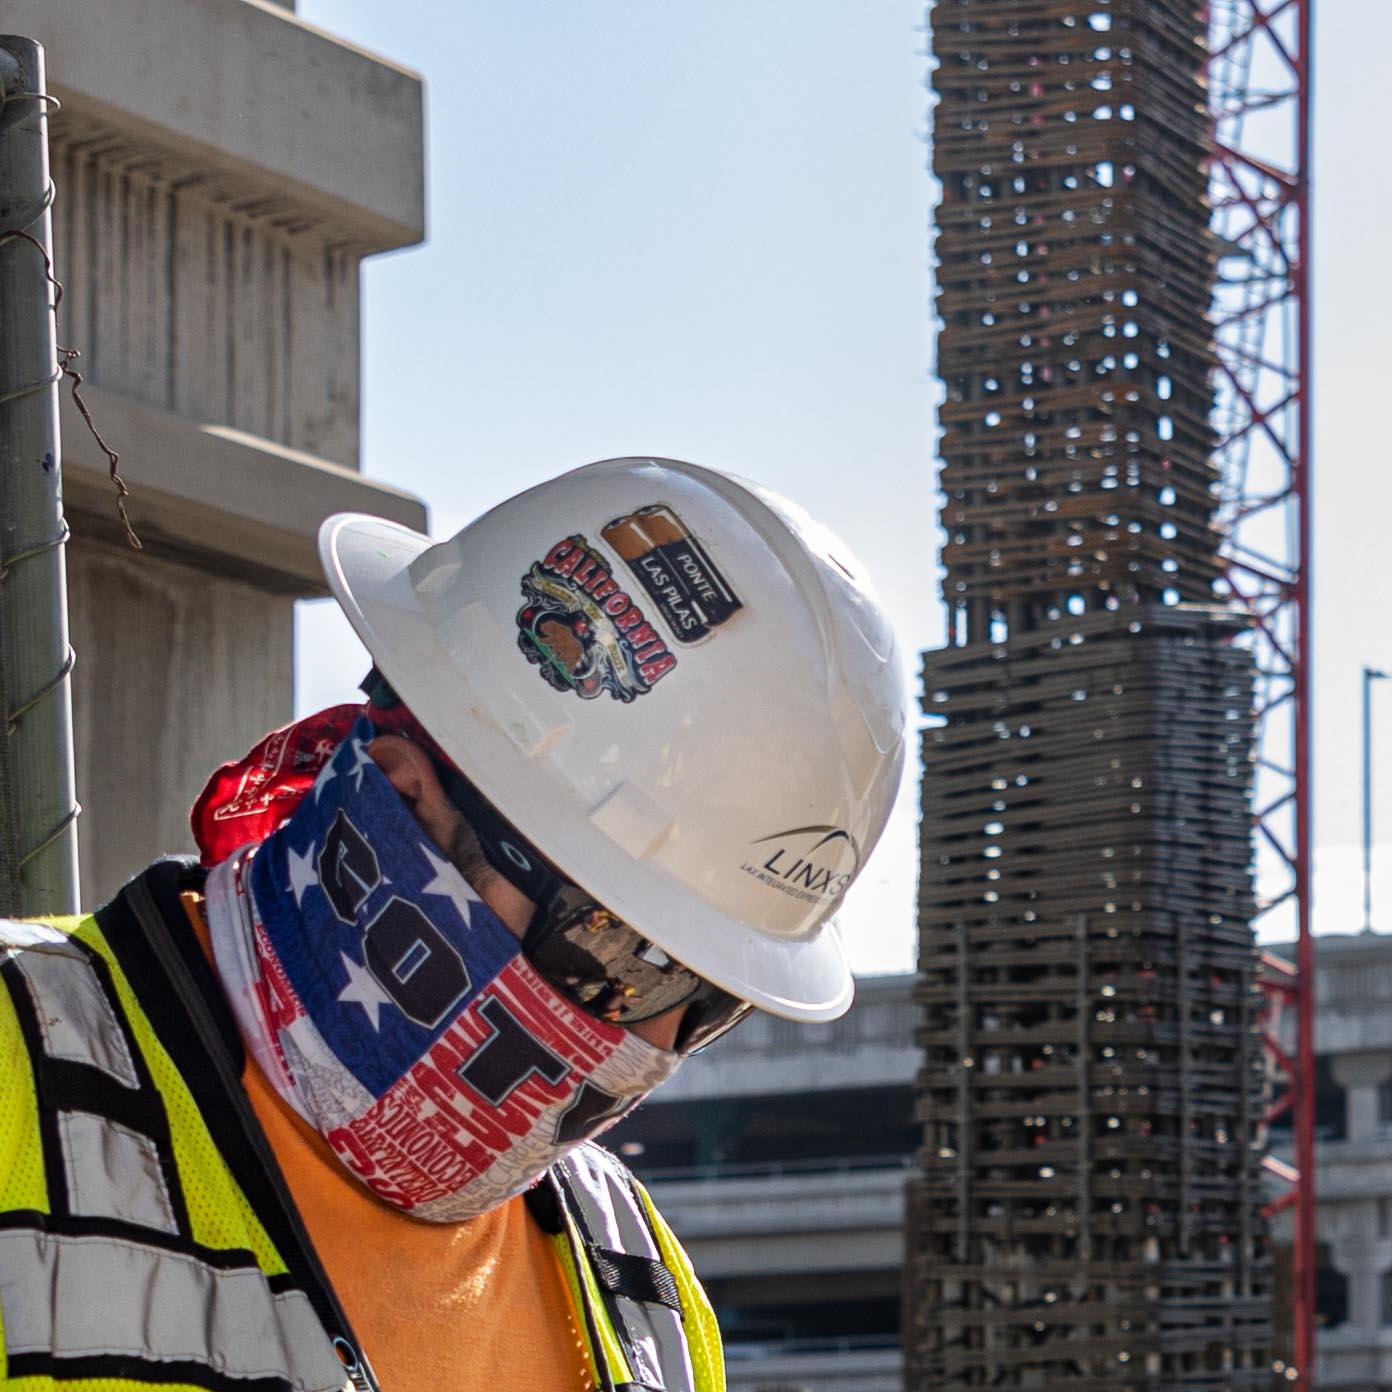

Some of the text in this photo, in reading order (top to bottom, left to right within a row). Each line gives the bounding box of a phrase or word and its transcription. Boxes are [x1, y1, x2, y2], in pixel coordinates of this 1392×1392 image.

[544, 539, 677, 685] CALIFORNIA
[641, 557, 669, 586] LAS
[661, 586, 698, 630] PILAS
[677, 553, 718, 602] PONTE
[764, 848, 851, 895] LINXS
[364, 1092, 481, 1196] ECONOMICS
